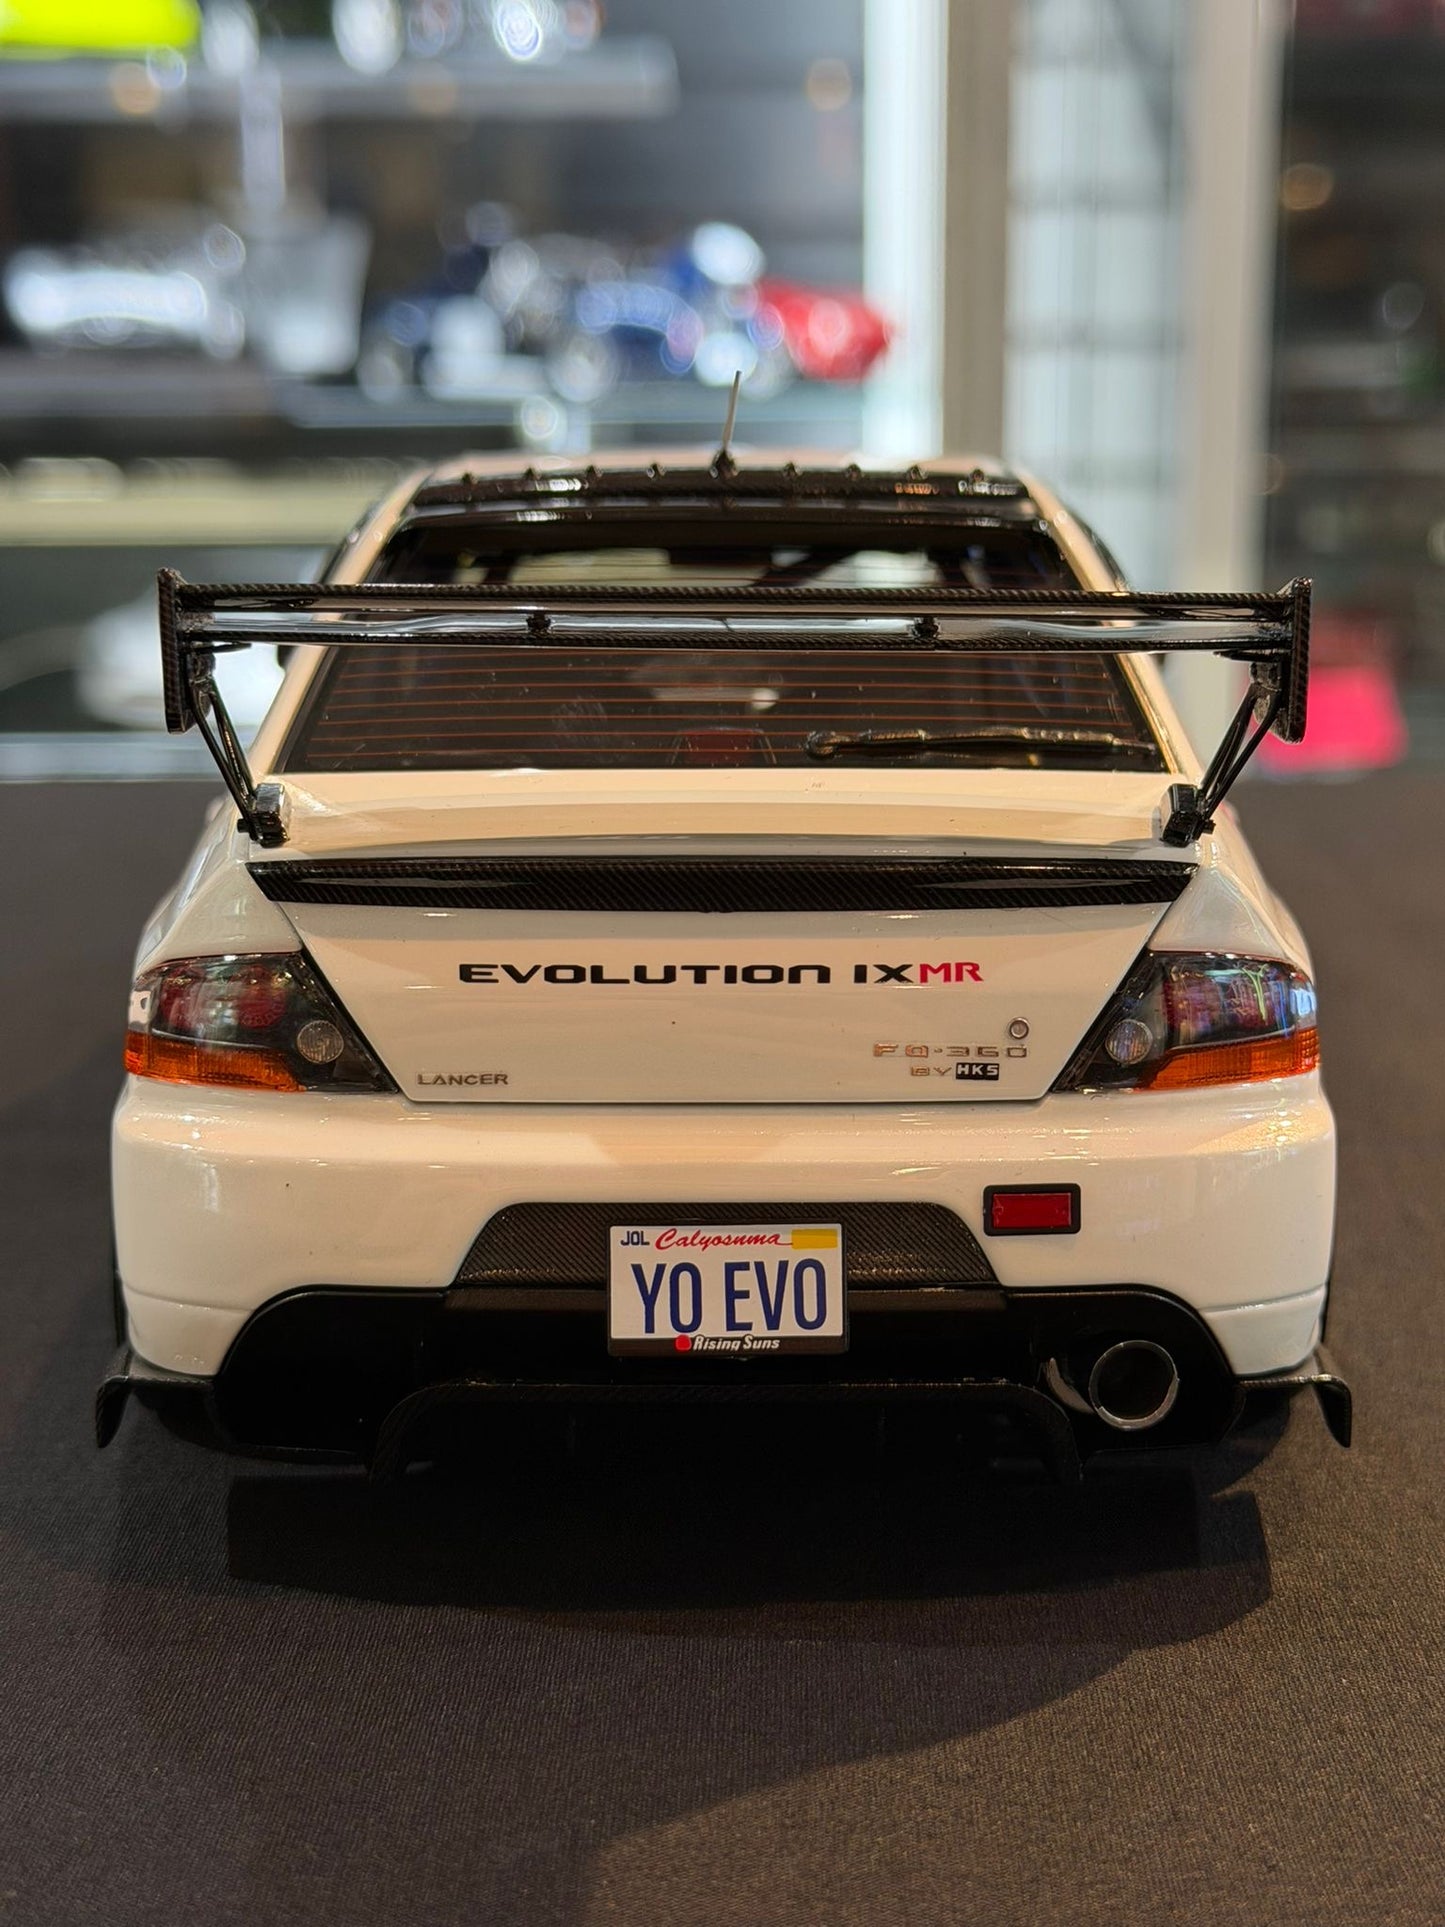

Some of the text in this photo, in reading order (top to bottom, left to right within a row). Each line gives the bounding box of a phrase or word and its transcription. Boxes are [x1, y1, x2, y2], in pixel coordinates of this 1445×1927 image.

[459, 963, 831, 984] EVOLUTION
[417, 1073, 509, 1086] LANCER
[911, 1062, 1000, 1081] BY HKS
[630, 1258, 827, 1334] YO EVO
[693, 1335, 780, 1351] Rising Suns
